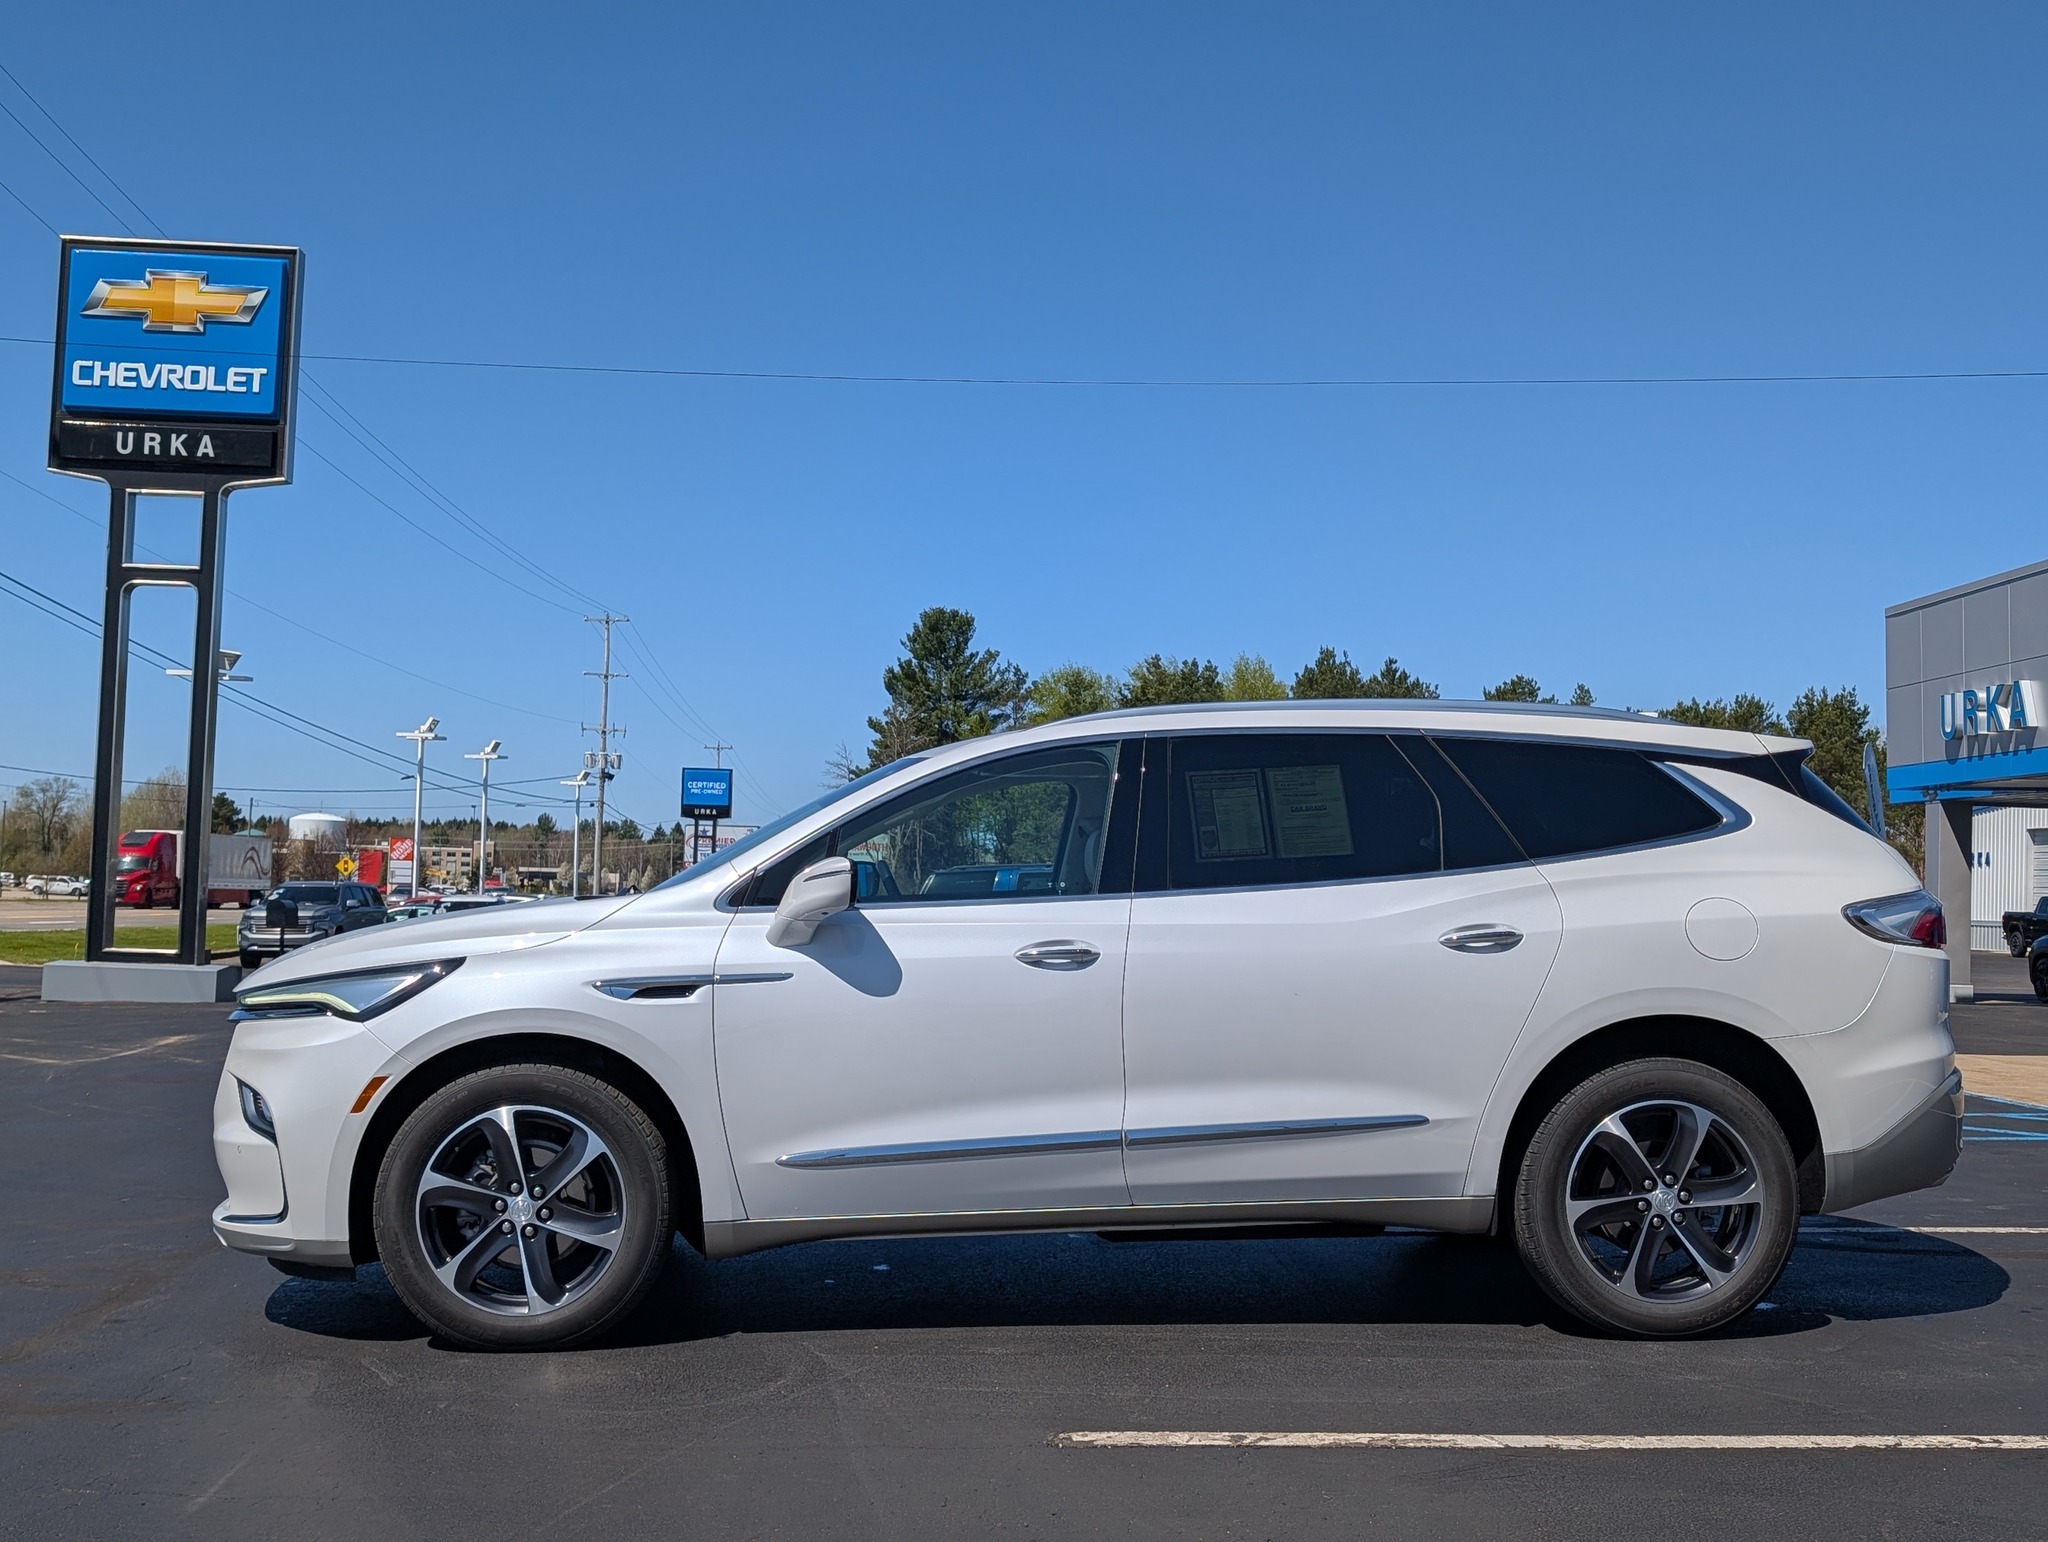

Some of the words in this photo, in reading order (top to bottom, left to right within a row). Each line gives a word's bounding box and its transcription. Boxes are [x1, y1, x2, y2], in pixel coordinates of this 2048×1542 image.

[72, 360, 267, 393] CHEVROLET
[116, 431, 215, 458] URKA
[1940, 680, 2036, 740] URKA
[688, 781, 726, 789] CERTIFIED
[390, 838, 414, 860] HOME
